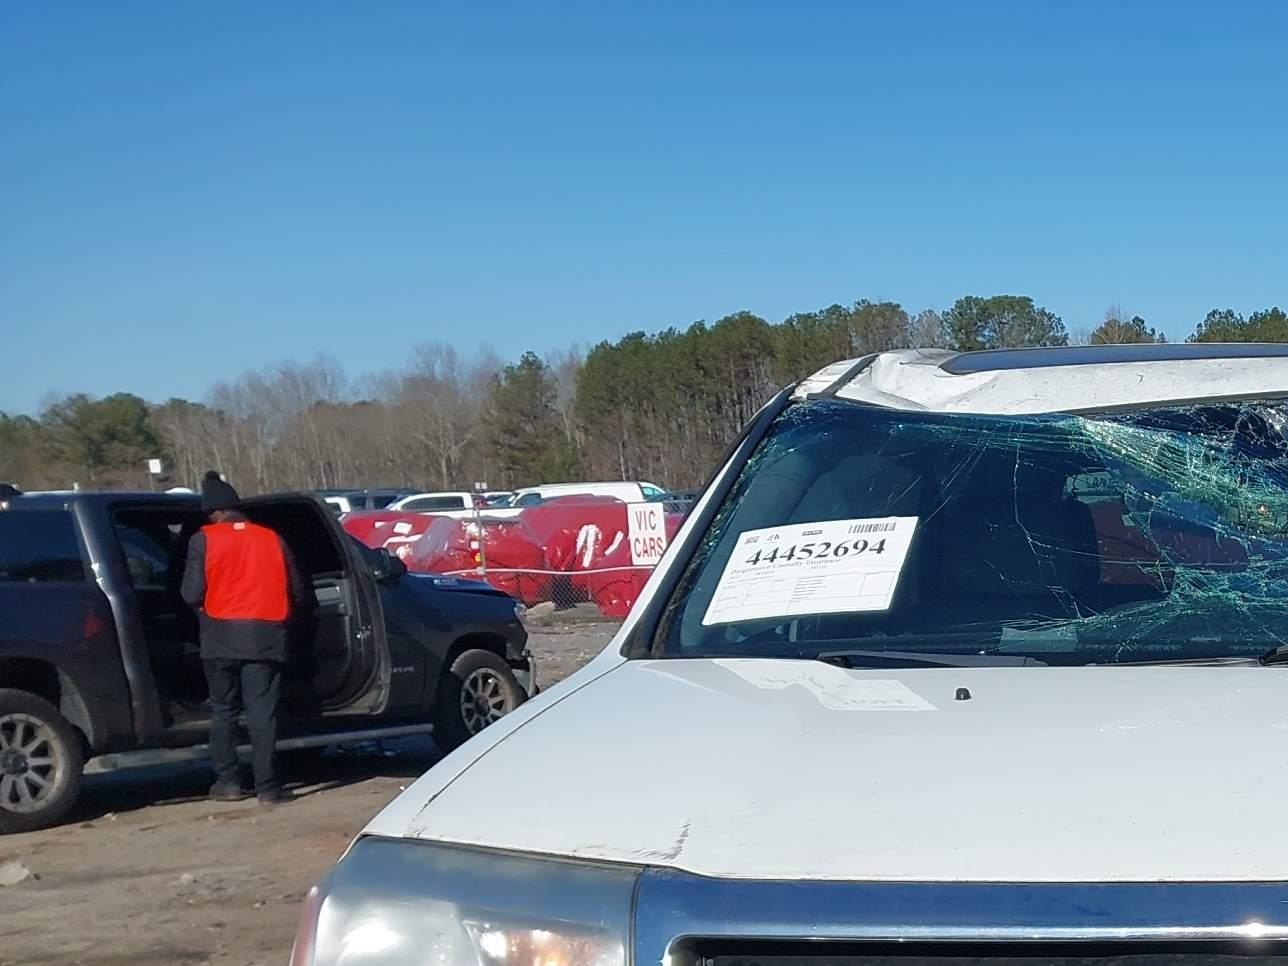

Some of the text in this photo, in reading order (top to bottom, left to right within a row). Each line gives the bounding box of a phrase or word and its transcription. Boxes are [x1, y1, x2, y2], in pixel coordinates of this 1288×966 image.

[634, 509, 657, 531] VIC
[633, 536, 664, 558] CARS
[745, 538, 887, 565] 44452694
